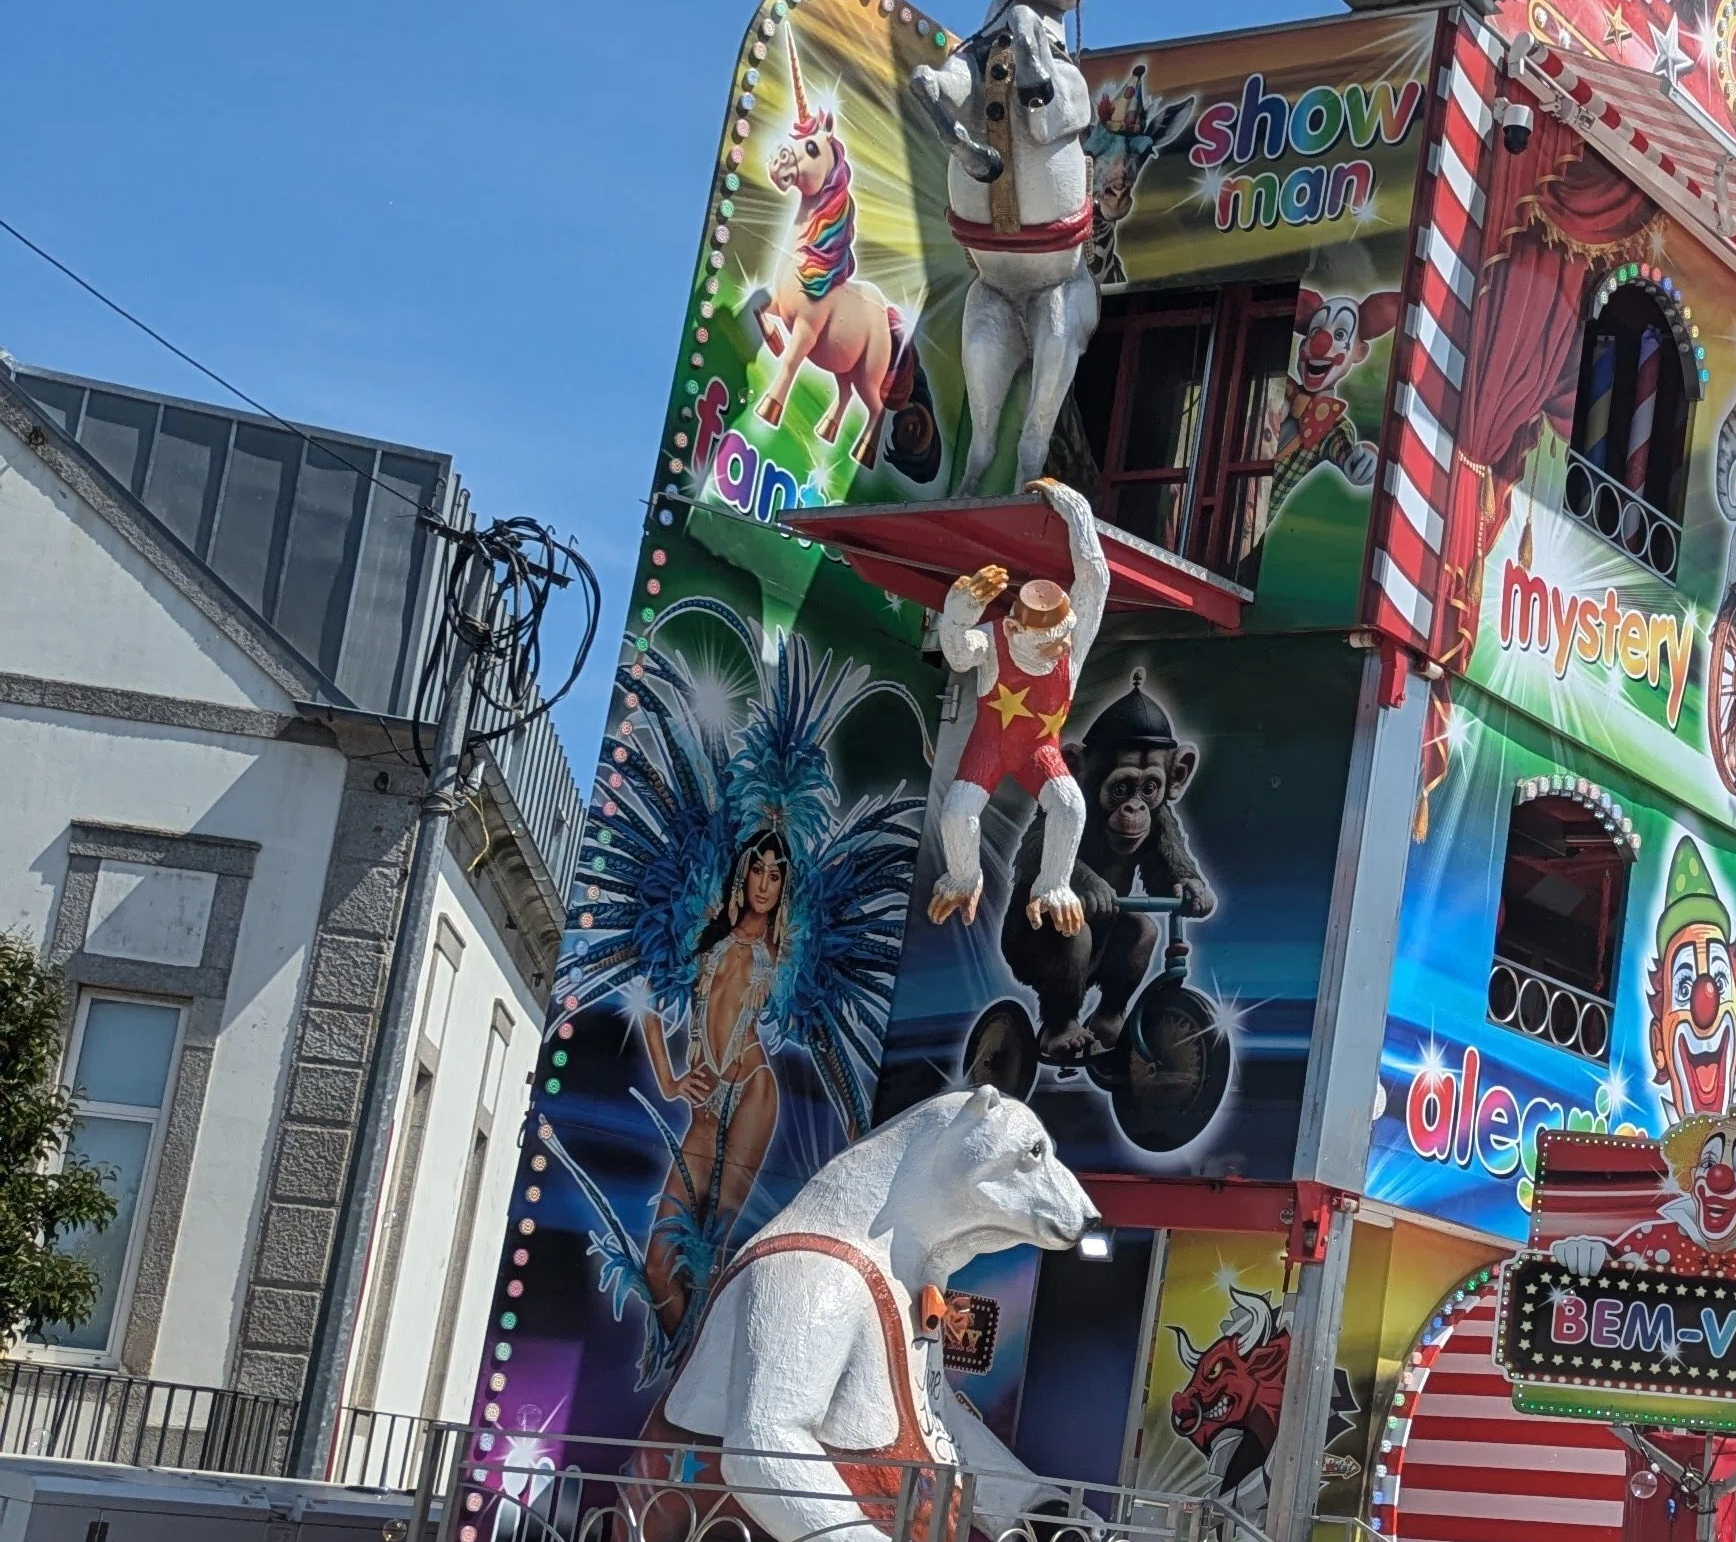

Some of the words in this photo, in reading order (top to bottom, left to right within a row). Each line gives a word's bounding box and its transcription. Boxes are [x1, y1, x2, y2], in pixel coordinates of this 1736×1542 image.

[1190, 73, 1424, 168] show
[1213, 159, 1376, 232] man
[1500, 556, 1694, 729] mystery
